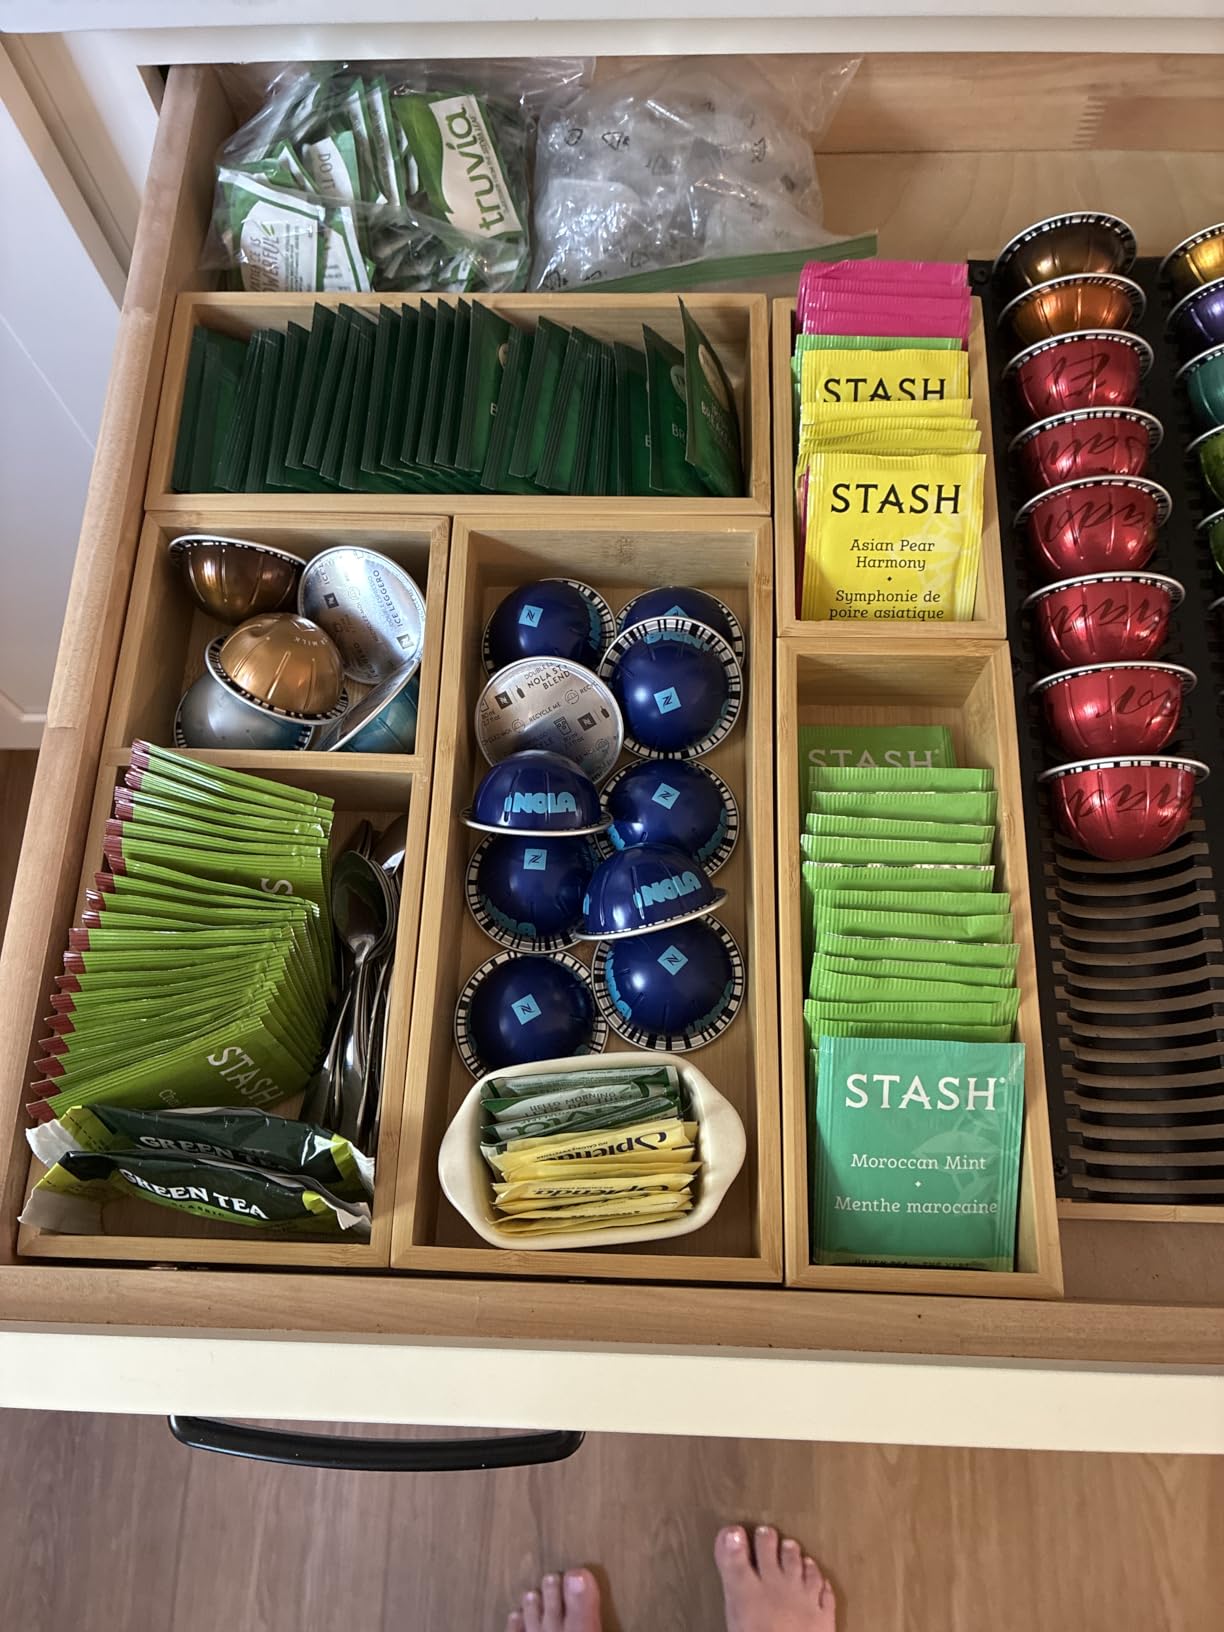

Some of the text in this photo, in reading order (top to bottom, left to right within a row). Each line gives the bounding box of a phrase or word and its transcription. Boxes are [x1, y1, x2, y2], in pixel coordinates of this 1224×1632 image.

[823, 378, 947, 402] STASH
[831, 484, 962, 514] STASH
[850, 538, 936, 552] Asian Pear
[856, 556, 926, 572] Harmony
[373, 570, 396, 612] LEGGERO
[836, 590, 941, 606] Symphonie de
[829, 606, 944, 620] poire asiatique
[527, 673, 552, 690] NOLA
[542, 670, 571, 690] BLEND
[808, 749, 933, 768] STASH
[512, 792, 576, 814] NOLA
[640, 871, 702, 908] NOLA
[206, 1046, 284, 1104] STASH
[565, 1092, 616, 1105] MORNING
[846, 1074, 998, 1110] STASH
[140, 1136, 235, 1160] GREEN
[850, 1153, 986, 1170] Moroccan Mint
[119, 1168, 270, 1220] GREEN TEA
[834, 1196, 998, 1214] Menthe marocaine
